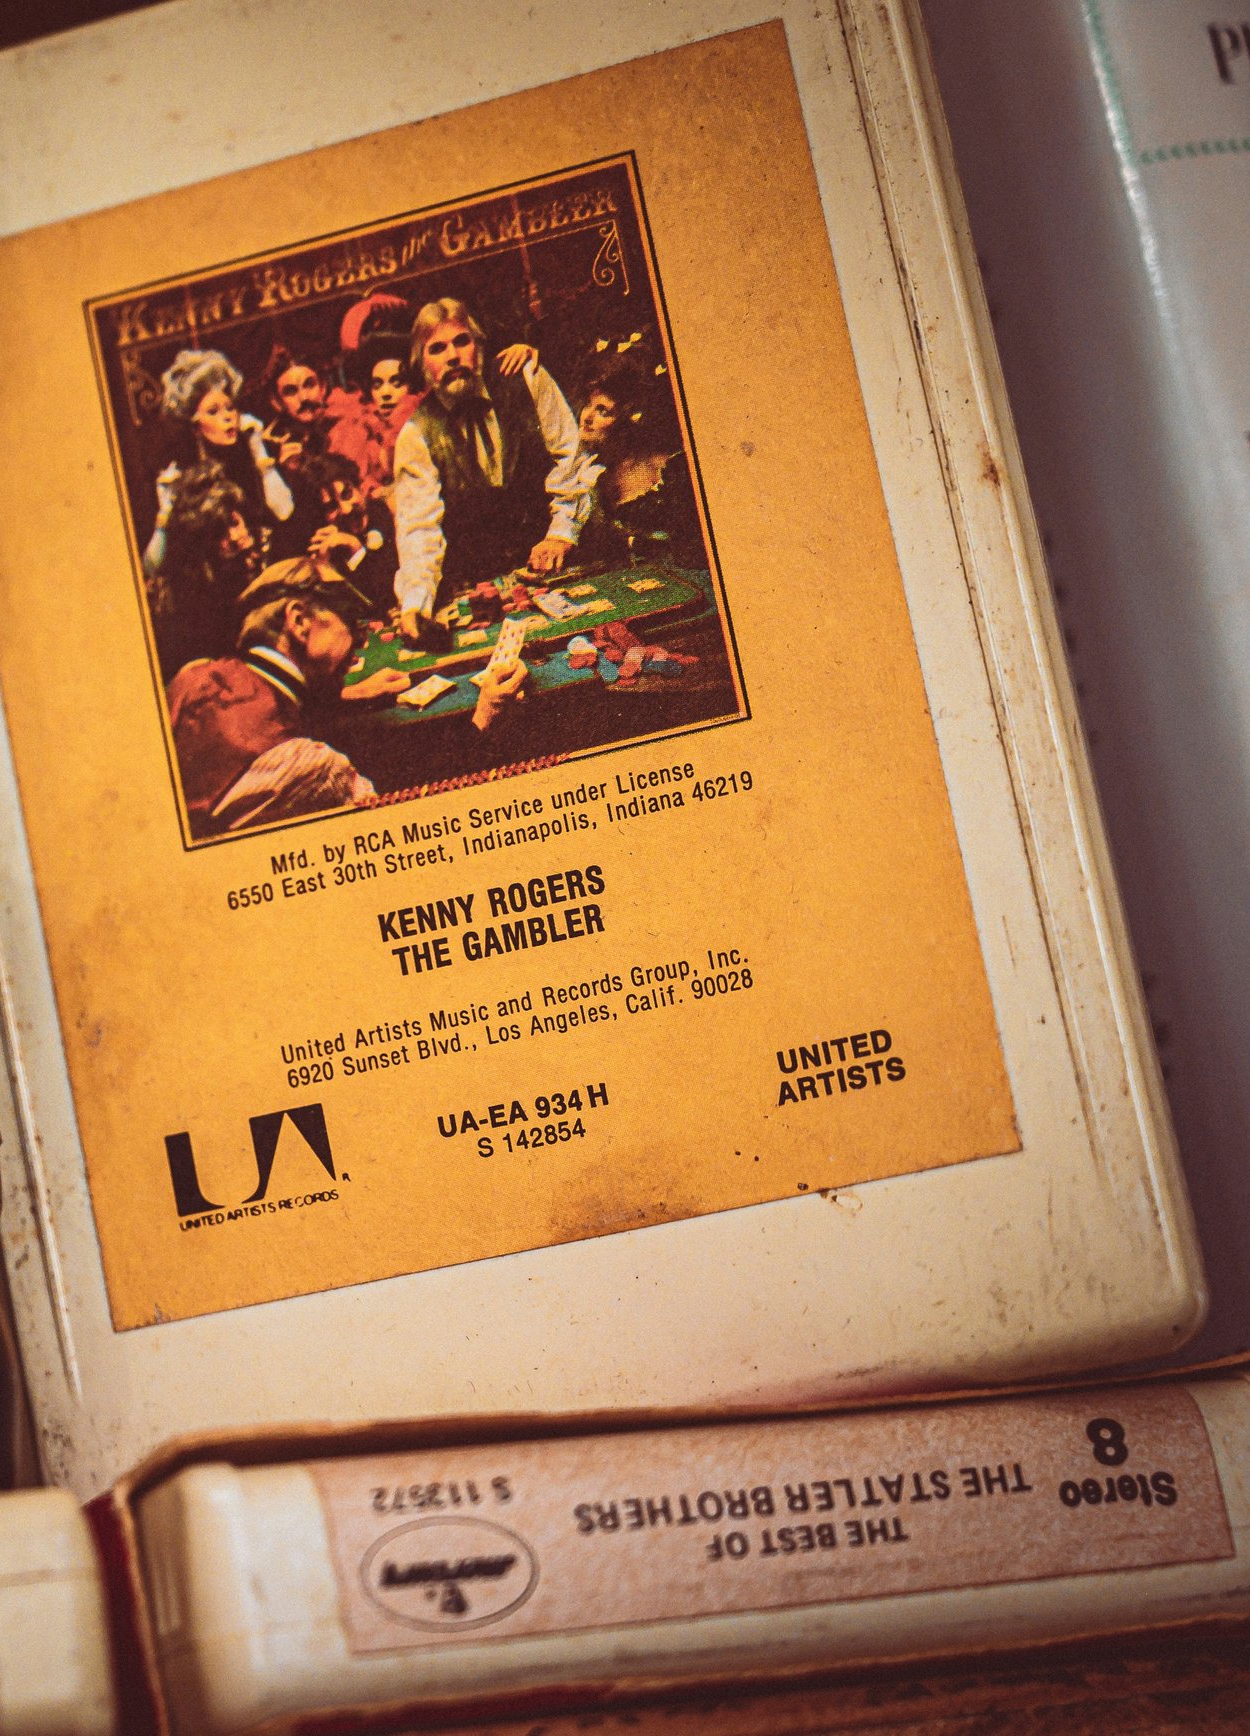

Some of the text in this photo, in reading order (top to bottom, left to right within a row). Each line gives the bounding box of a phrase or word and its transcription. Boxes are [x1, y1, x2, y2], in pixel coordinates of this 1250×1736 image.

[227, 770, 755, 912] 6550 East 30th Street, Indianapolis, Indiana 46219
[270, 762, 696, 876] Mfd. by RCA Music Service under License
[377, 865, 606, 943] KENNY ROGERS
[392, 904, 606, 977] THE GAMBLER
[281, 946, 749, 1065] United Artists Music and Records Group, Inc.
[286, 967, 754, 1089] 6920 Sunset Blvd., Los Angeles, Calif. 90028
[776, 1029, 892, 1074] UNITED
[778, 1057, 906, 1106] ARTISTS
[436, 1082, 610, 1139] UA-EA 934 H
[476, 1119, 587, 1158] S 142854
[179, 1189, 339, 1232] UNITED ARTISTS RECORDS
[1086, 1417, 1130, 1467] 8
[490, 1476, 513, 1505] S
[572, 1463, 1034, 1534] THE STATLER BROTHERS
[1058, 1470, 1179, 1510] Stereo
[705, 1514, 910, 1560] THE BEST OF
